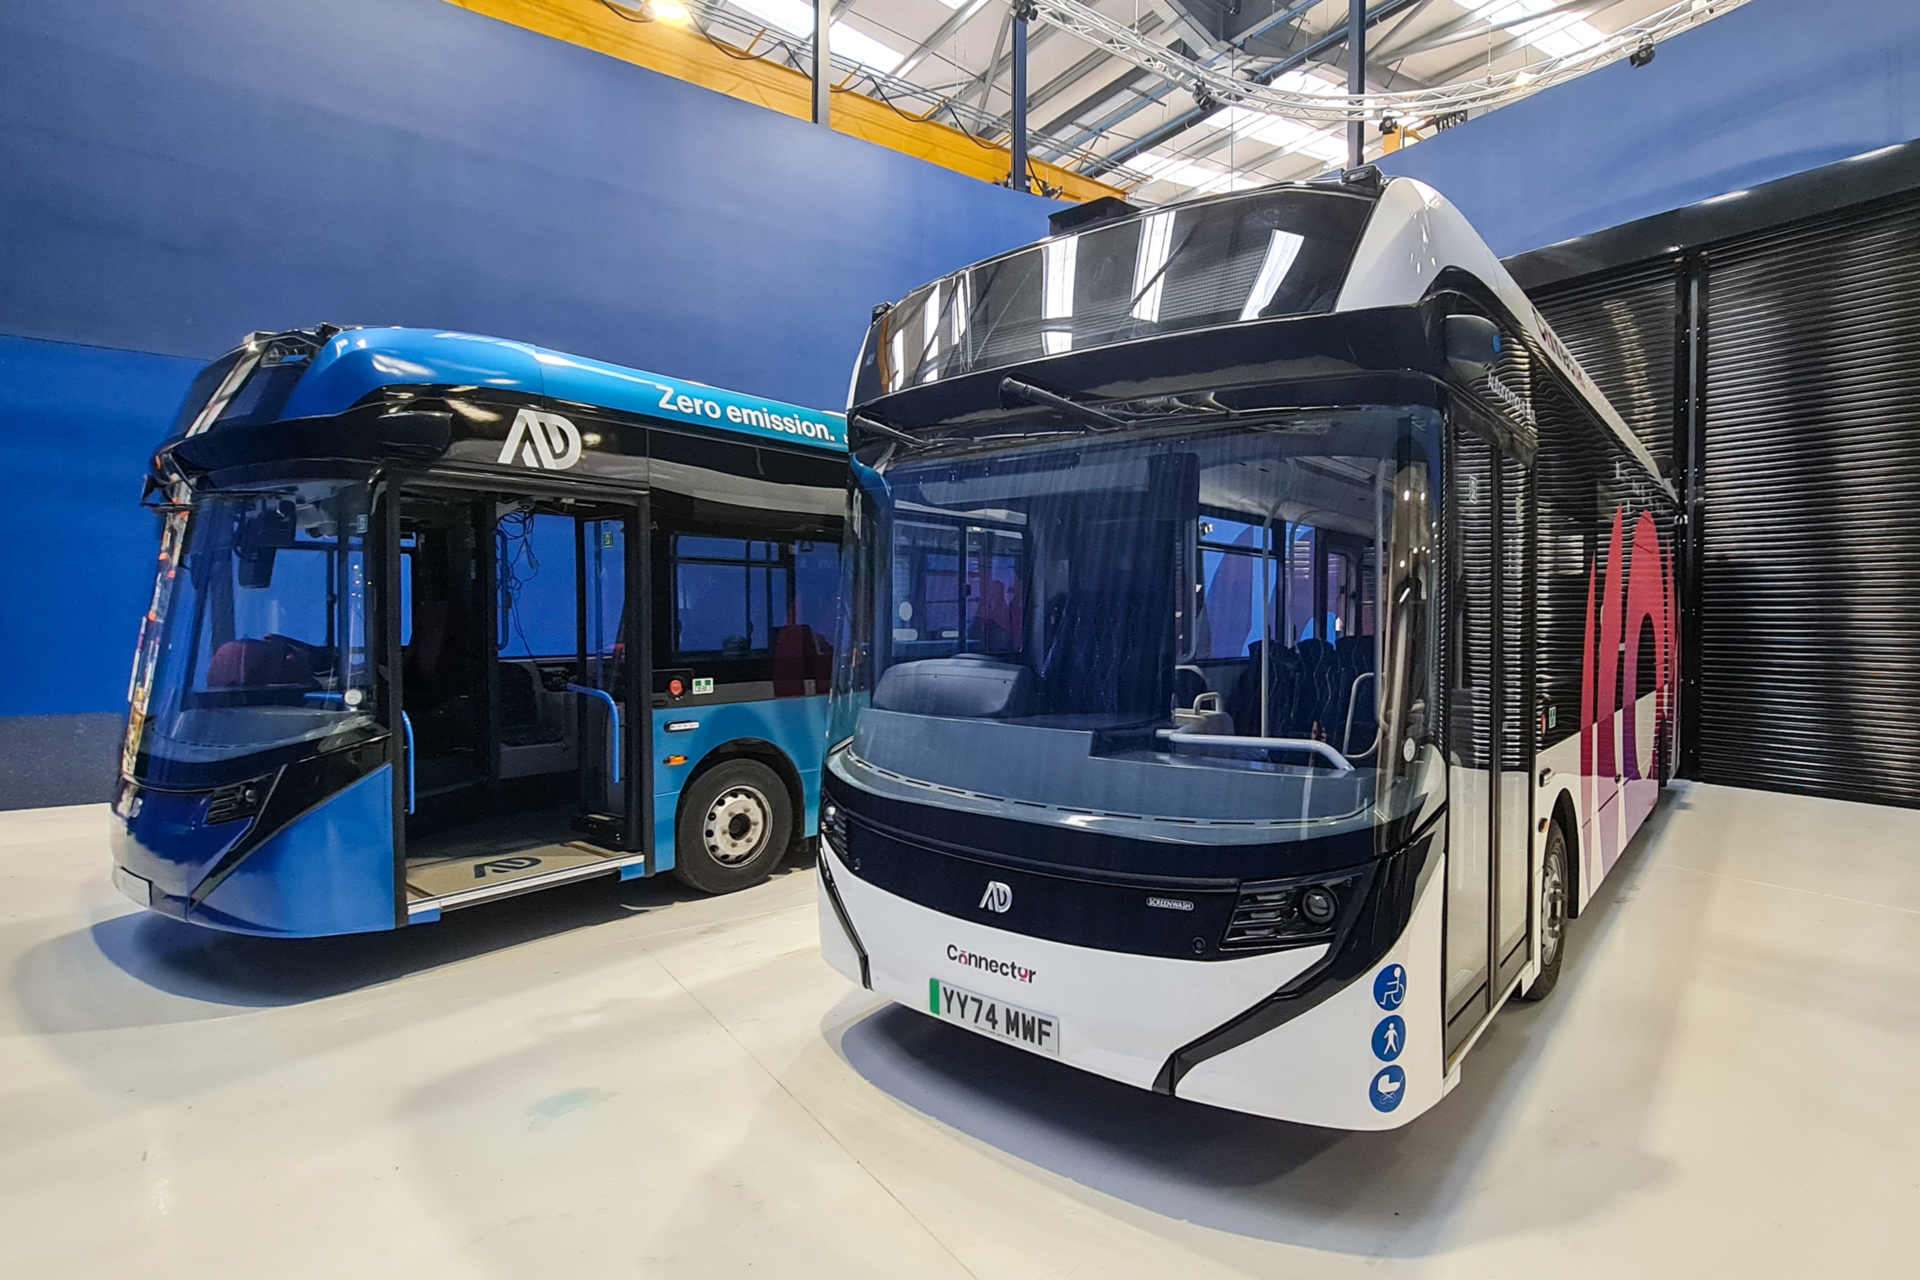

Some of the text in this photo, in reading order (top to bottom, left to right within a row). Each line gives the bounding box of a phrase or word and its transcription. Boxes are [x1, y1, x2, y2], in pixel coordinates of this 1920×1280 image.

[655, 384, 836, 442] Zero emission.
[1147, 897, 1192, 910] SCREENWASH
[946, 944, 1037, 983] Connector
[942, 986, 1053, 1047] YY74 MWF
